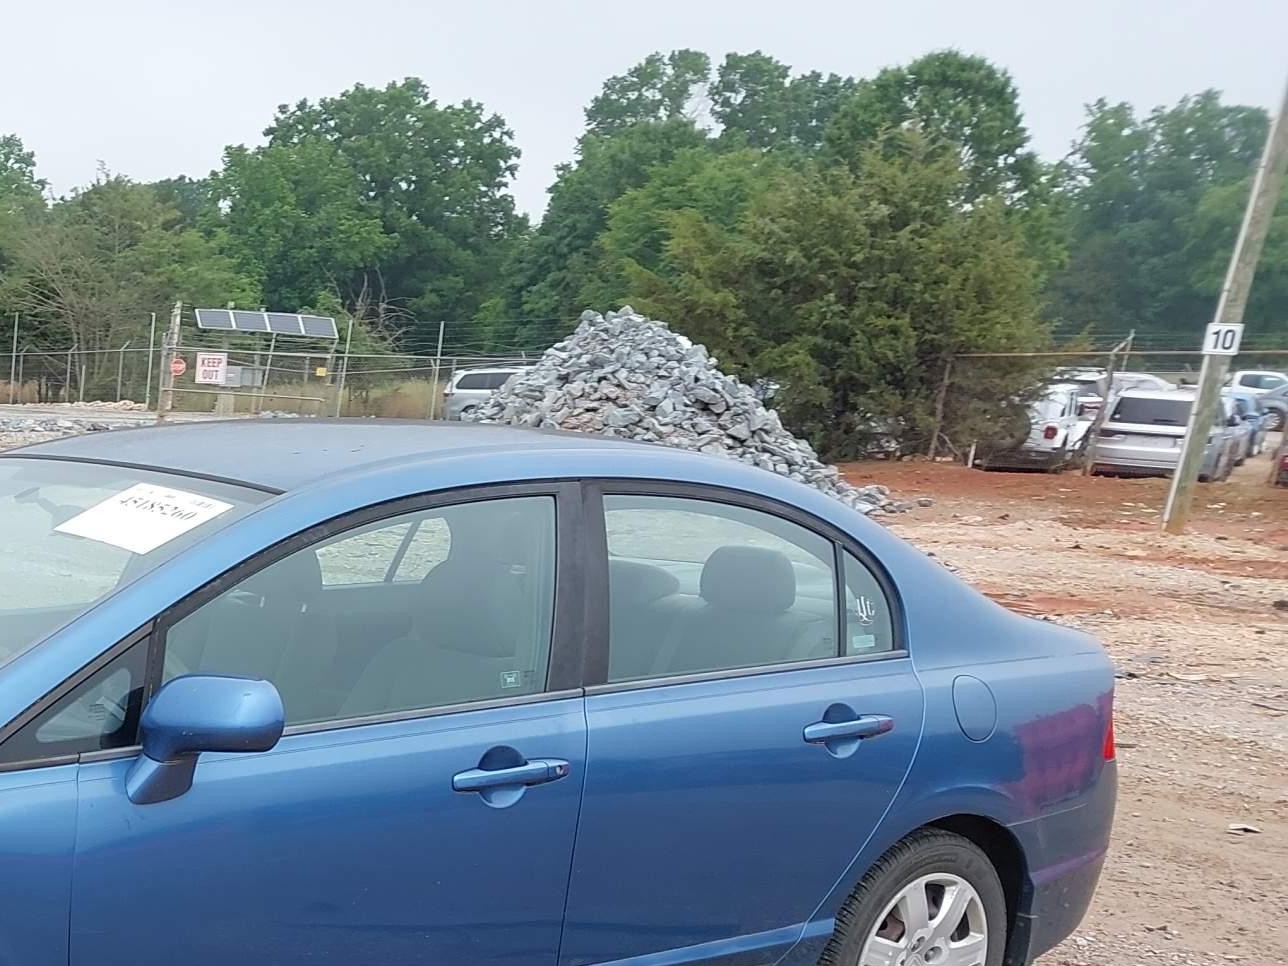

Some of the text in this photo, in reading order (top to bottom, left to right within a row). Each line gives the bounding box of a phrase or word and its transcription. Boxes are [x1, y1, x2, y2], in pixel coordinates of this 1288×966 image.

[1212, 329, 1236, 350] 10
[200, 357, 223, 368] KEEP
[201, 369, 220, 380] OUT
